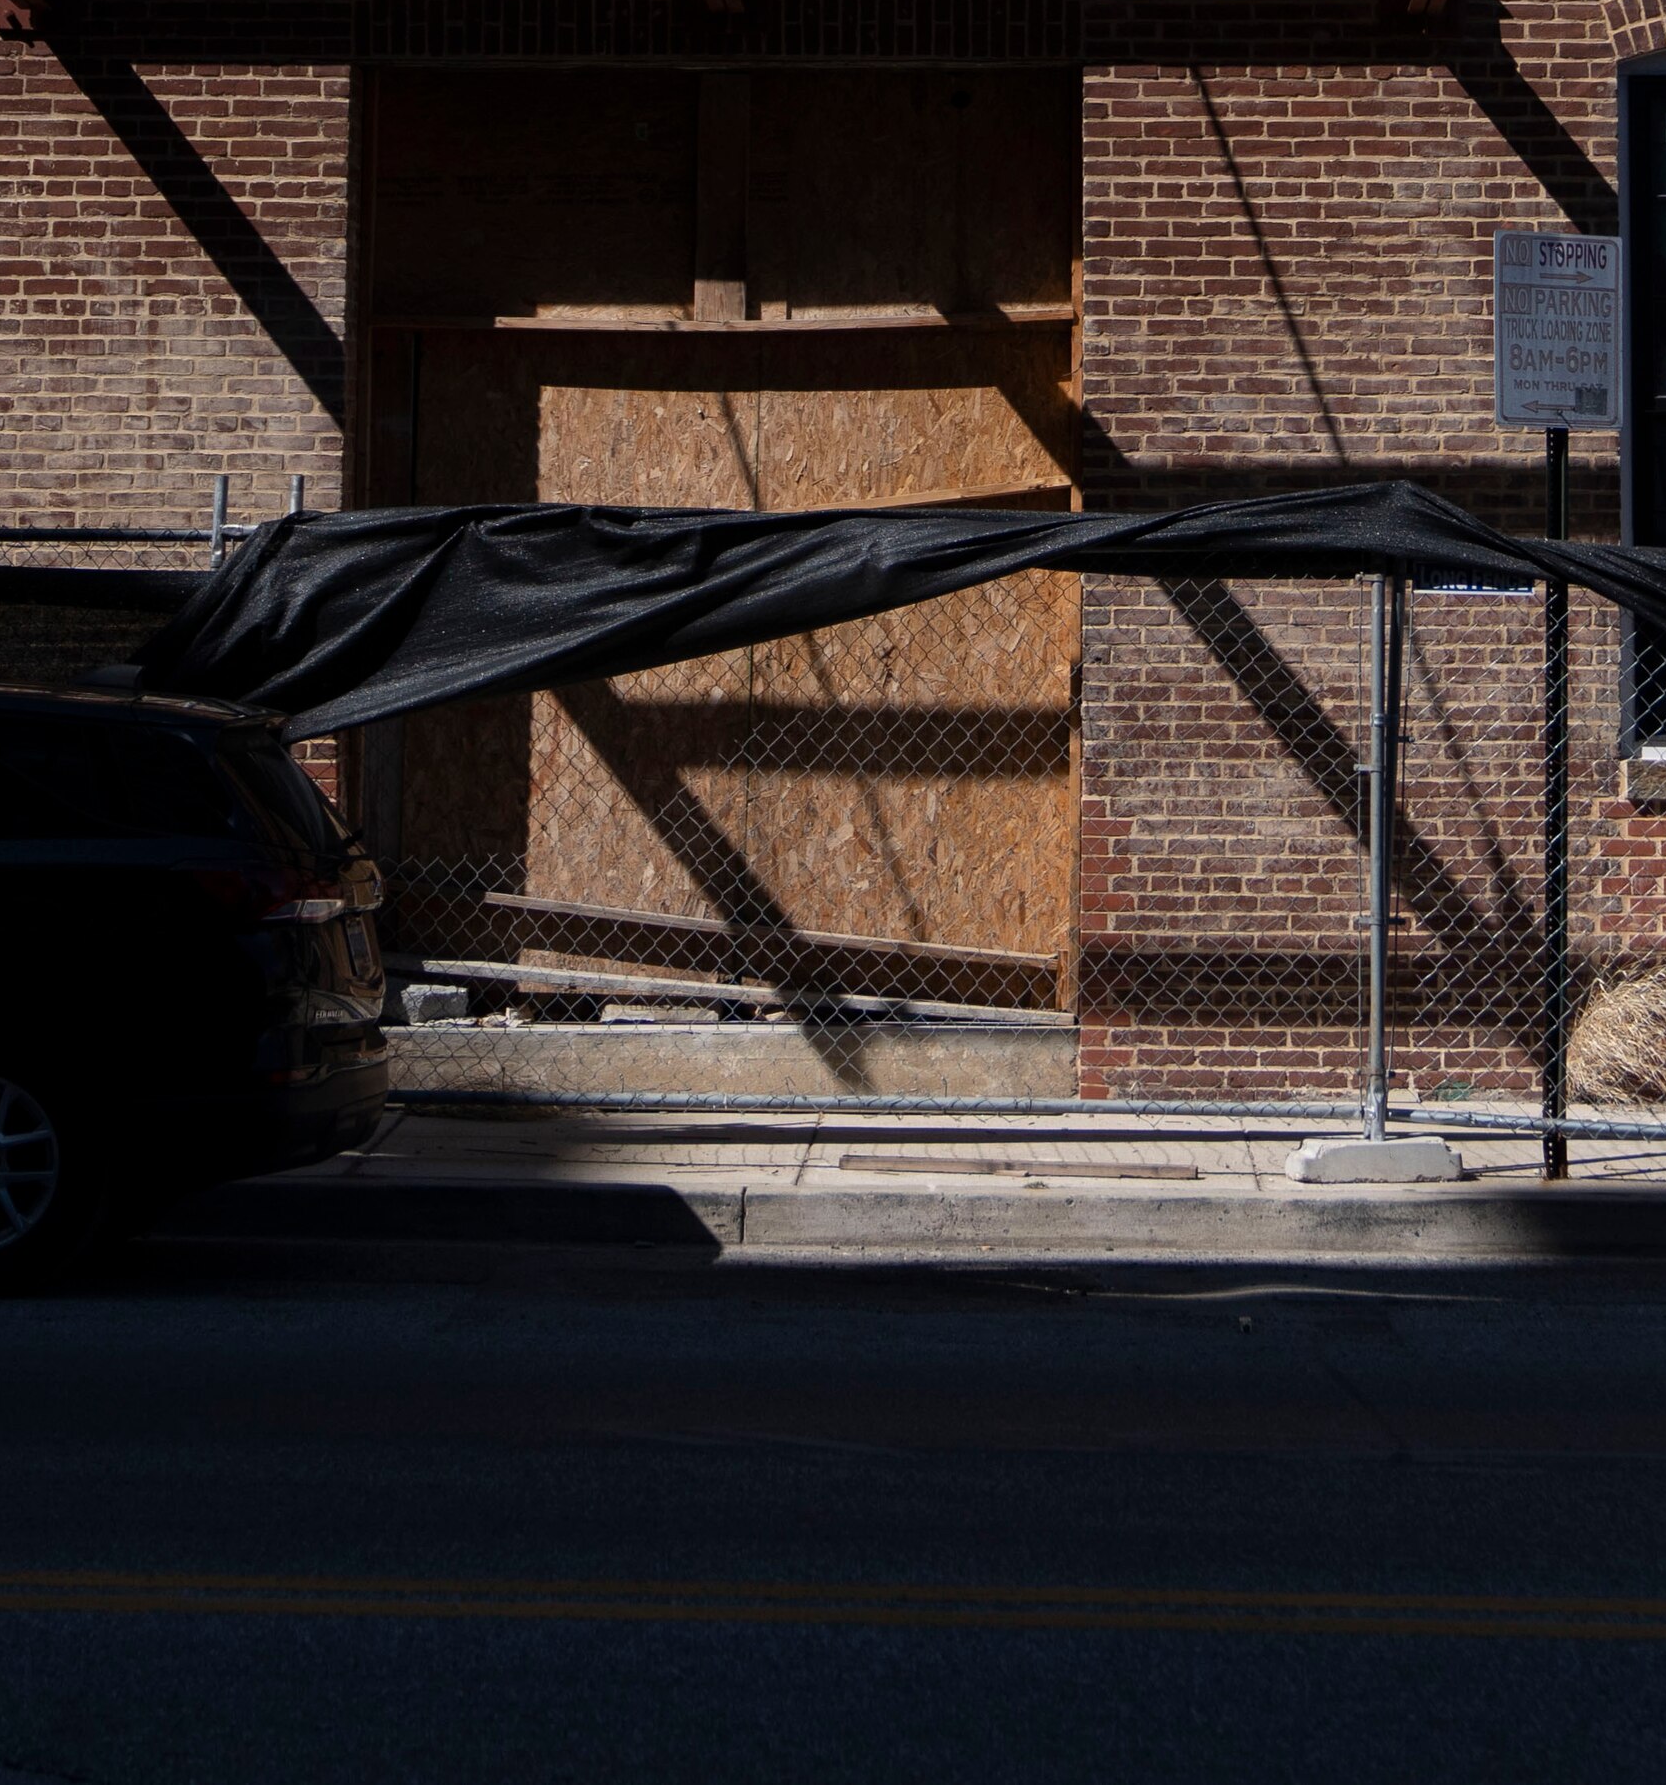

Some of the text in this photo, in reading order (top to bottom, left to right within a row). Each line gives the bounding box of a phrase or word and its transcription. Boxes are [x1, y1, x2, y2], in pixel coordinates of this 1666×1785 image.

[1504, 239, 1608, 270] NO STOPPING
[1504, 286, 1612, 320] NO PARKING
[1505, 317, 1612, 344] TRUCK LOADING ZONE
[1509, 344, 1609, 376] 8AM-6PM
[1513, 378, 1540, 391] MON
[1543, 379, 1575, 393] THRU
[1419, 566, 1468, 589] LONG
